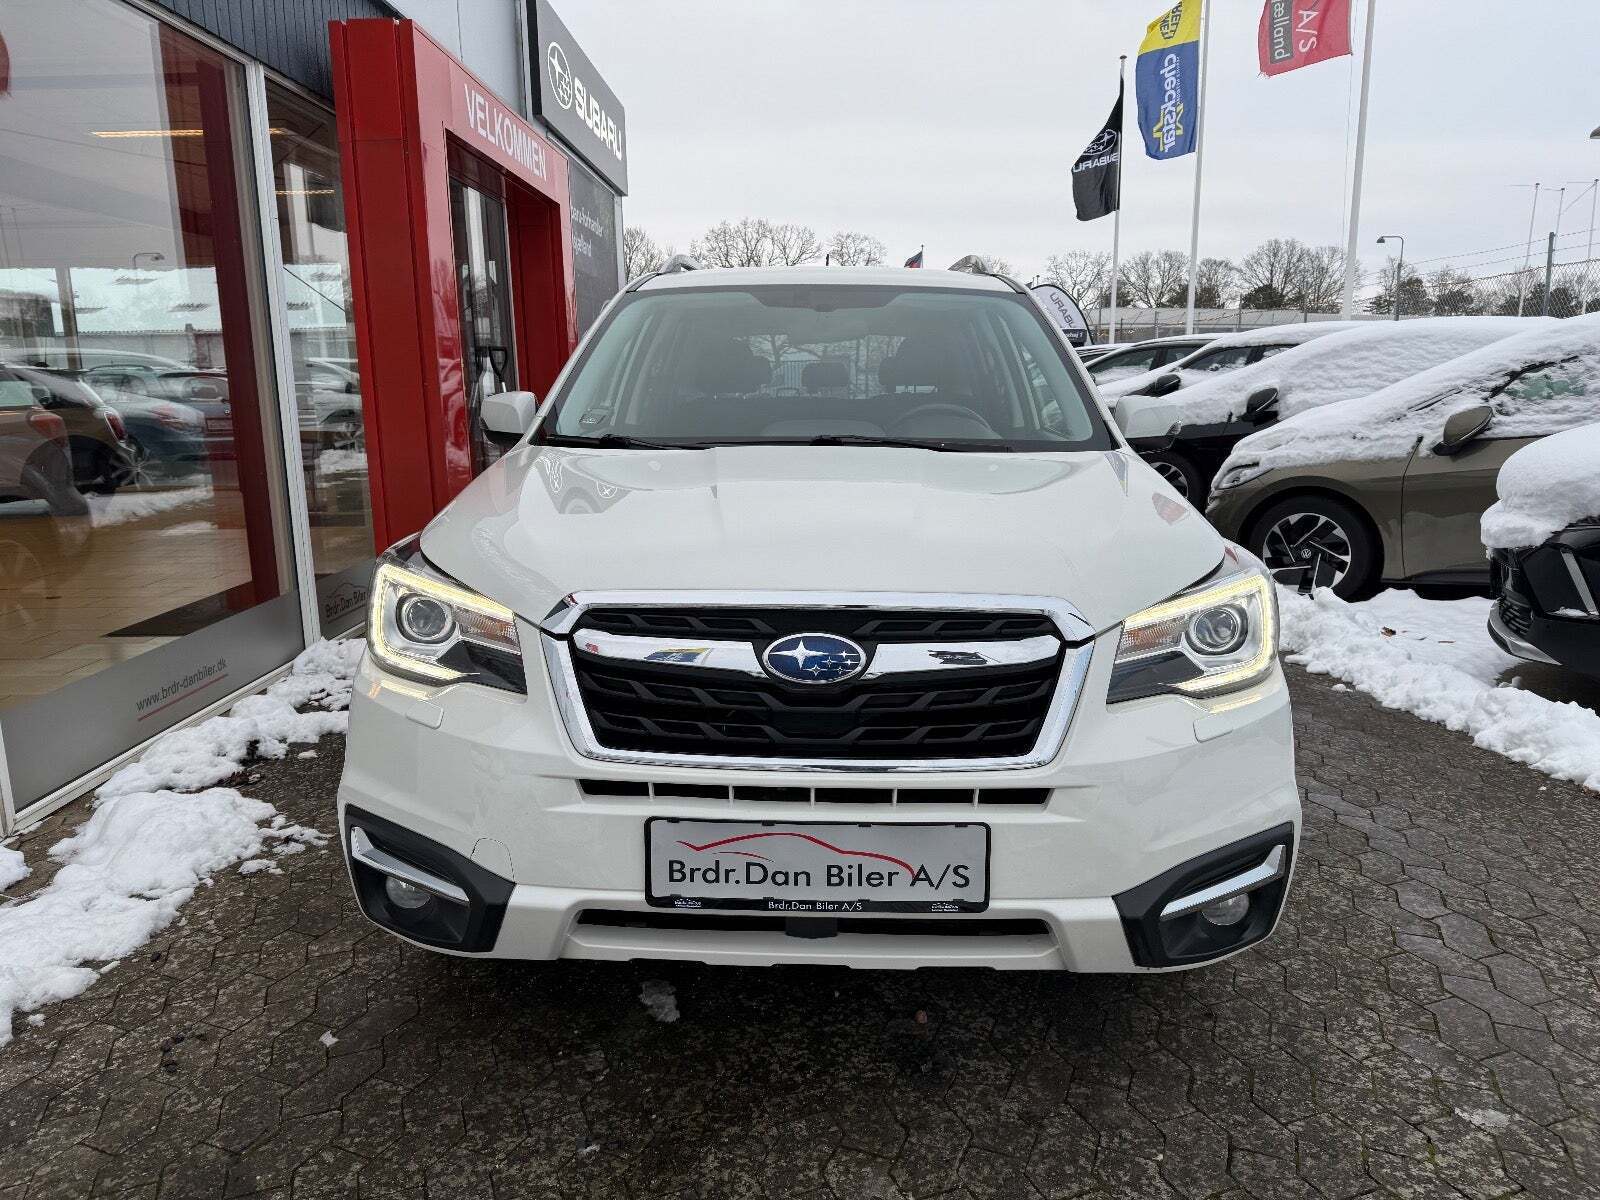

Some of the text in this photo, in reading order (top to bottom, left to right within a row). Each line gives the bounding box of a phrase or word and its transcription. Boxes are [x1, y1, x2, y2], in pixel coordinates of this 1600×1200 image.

[1272, 0, 1291, 60] ælland
[1296, 9, 1319, 53] A/S
[464, 83, 547, 181] VELKOMMEN
[574, 76, 622, 161] SUBARU
[135, 657, 228, 712] www.brdr-danbiler.dk
[826, 864, 900, 888] Biler
[910, 863, 970, 890] A/S
[816, 902, 840, 911] Biler
[842, 902, 862, 912] A/S
